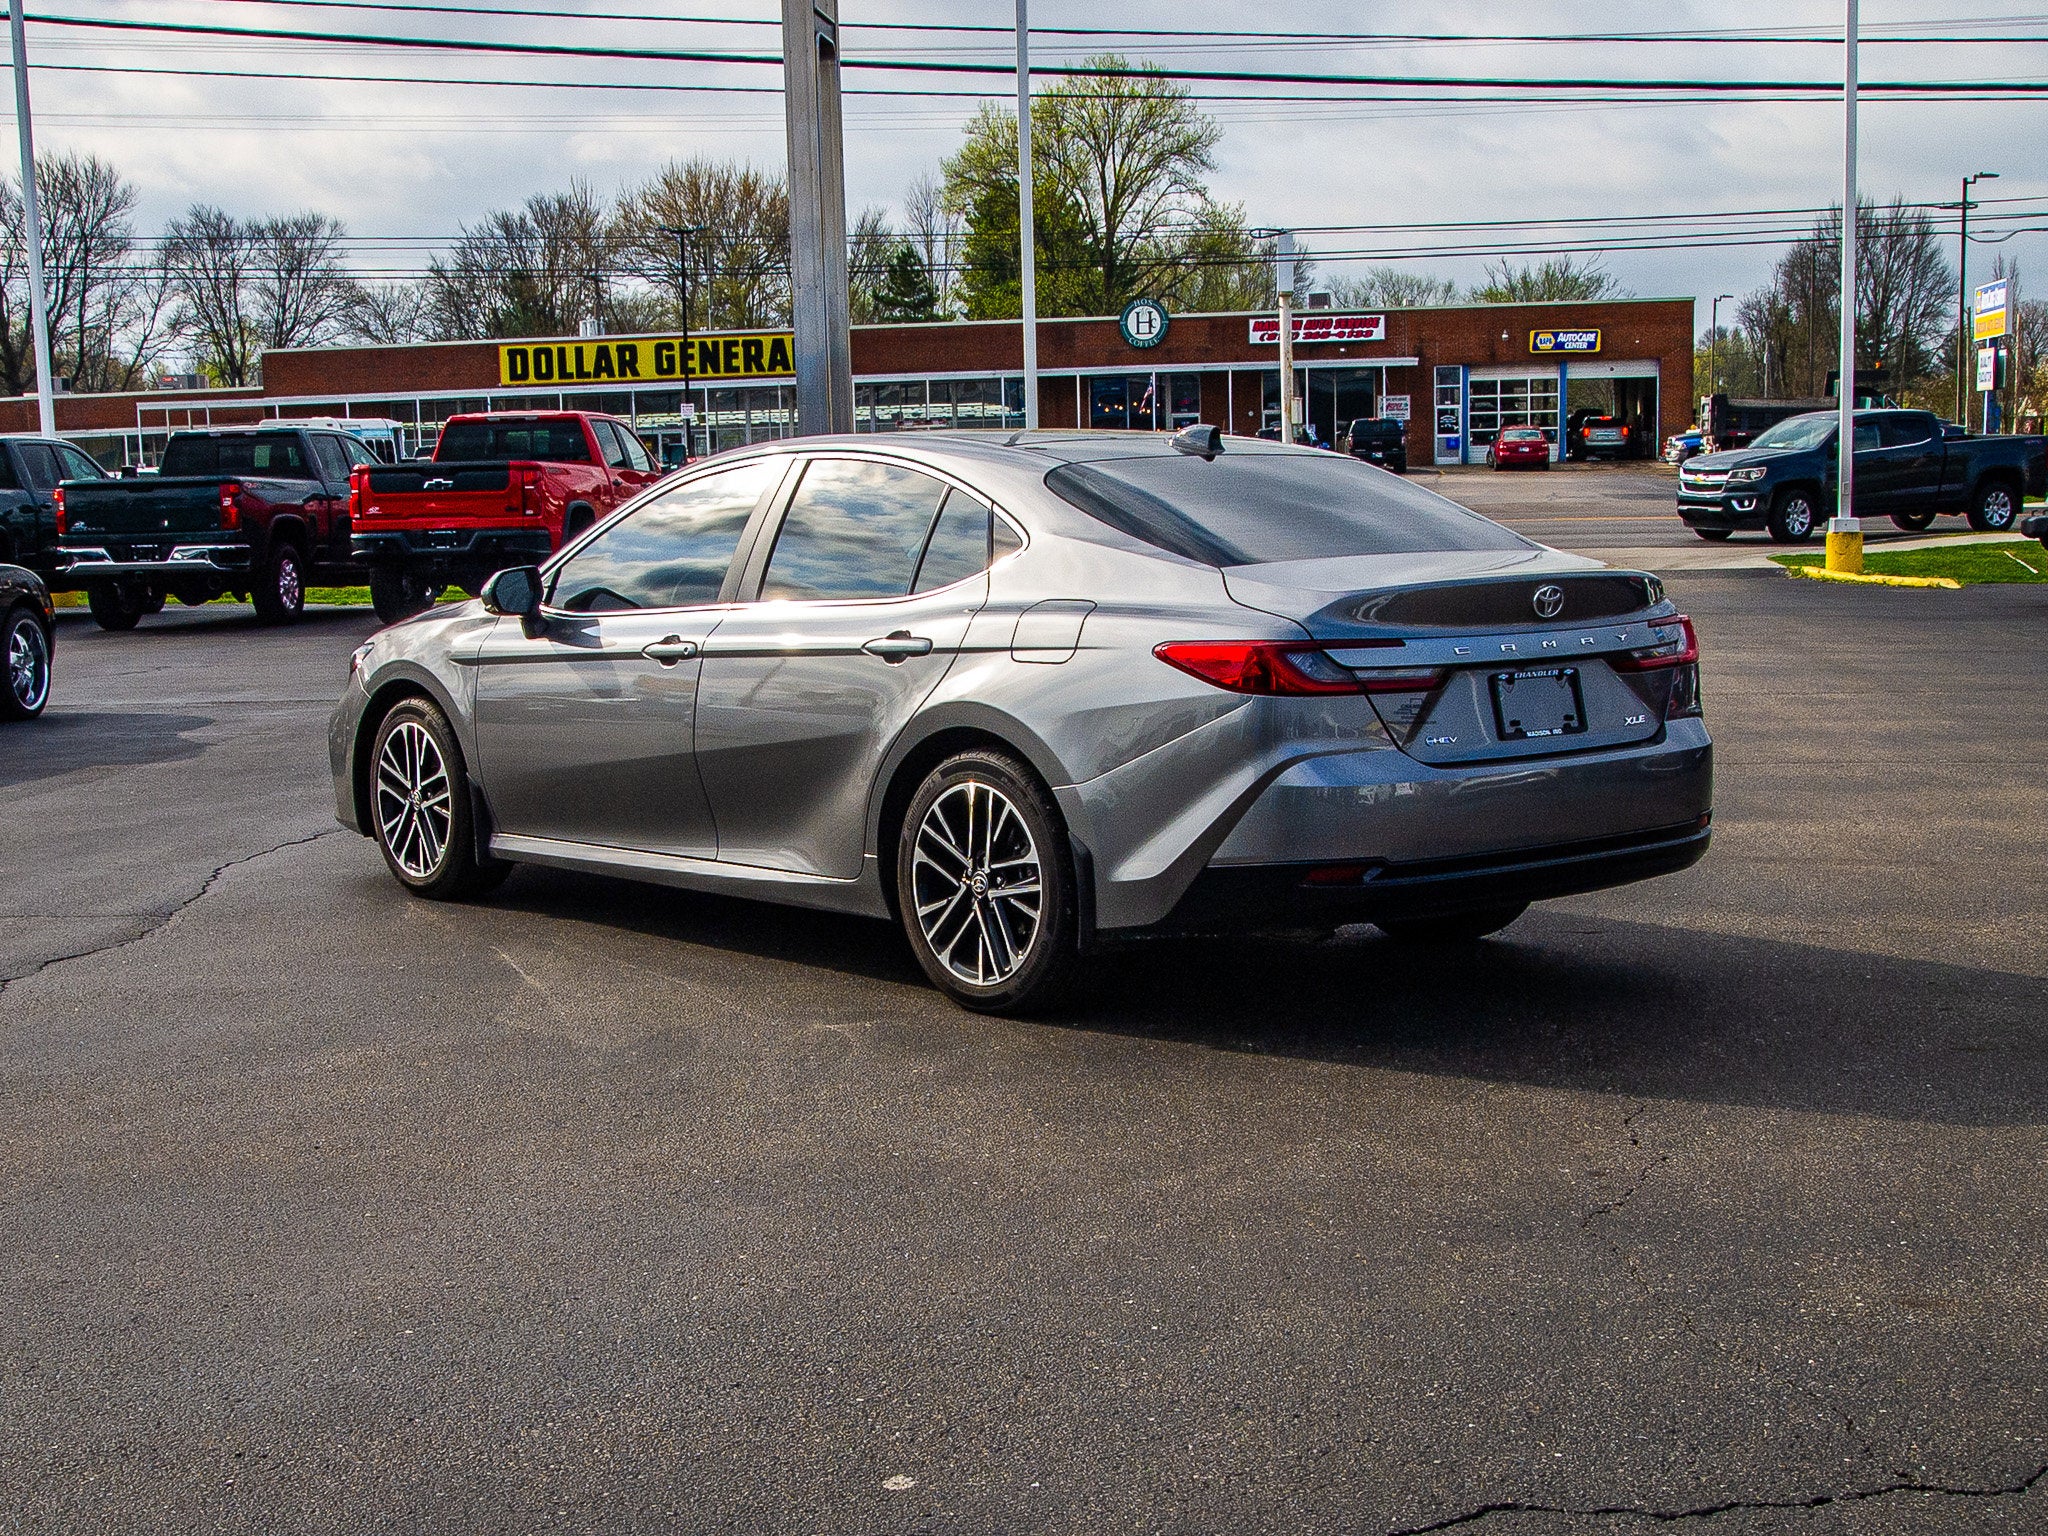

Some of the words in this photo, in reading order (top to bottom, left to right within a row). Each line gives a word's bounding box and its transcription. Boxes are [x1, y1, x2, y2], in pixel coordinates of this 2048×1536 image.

[1303, 318, 1333, 330] AUTO
[1333, 316, 1381, 329] SERVICE
[1564, 341, 1588, 350] CENTER
[507, 343, 641, 382] DOLLAR
[654, 338, 796, 376] GENERA
[1453, 633, 1629, 655] CAMRY
[1514, 668, 1559, 681] CHANDLER
[1624, 714, 1646, 727] XLE
